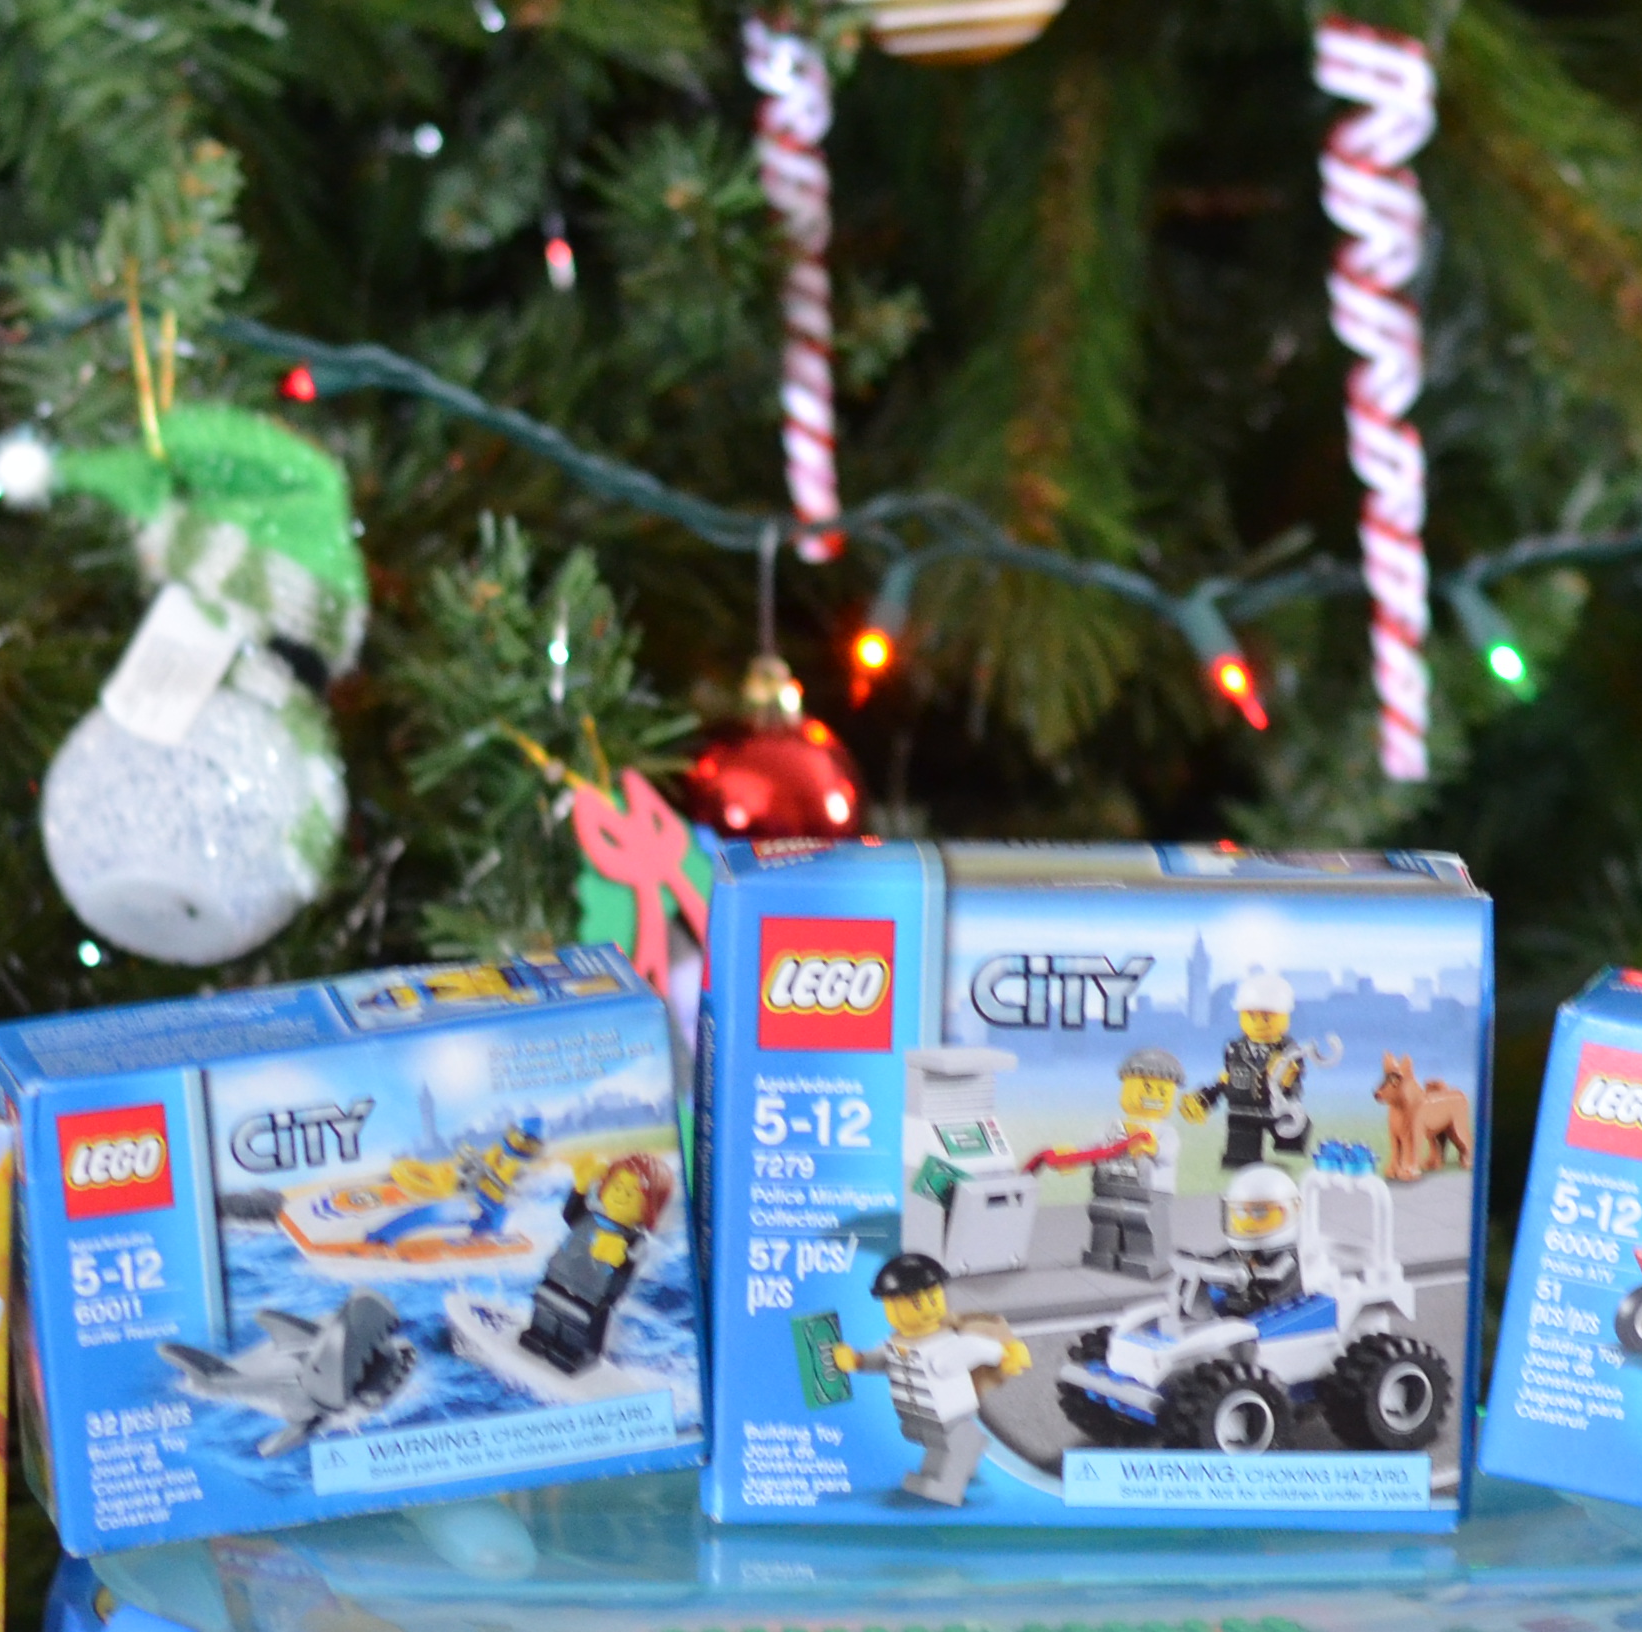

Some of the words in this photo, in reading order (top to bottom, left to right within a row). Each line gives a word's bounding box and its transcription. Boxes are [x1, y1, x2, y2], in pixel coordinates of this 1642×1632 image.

[765, 952, 889, 1013] LEGO
[752, 1096, 873, 1148] 5-12
[66, 1130, 165, 1190] LEGO
[753, 1154, 816, 1180] 7279
[750, 1183, 807, 1206] Police
[749, 1205, 840, 1229] Collection
[748, 1237, 791, 1272] 57
[1544, 1225, 1620, 1265] 60006
[71, 1247, 165, 1298] 5-12
[1535, 1275, 1563, 1303] 51
[74, 1293, 143, 1327] 60011
[747, 1275, 795, 1318] pzs
[86, 1409, 119, 1438] 32
[366, 1431, 488, 1462] WARNING:
[1118, 1459, 1240, 1485] WARNING:
[1245, 1466, 1332, 1486] CHOKING
